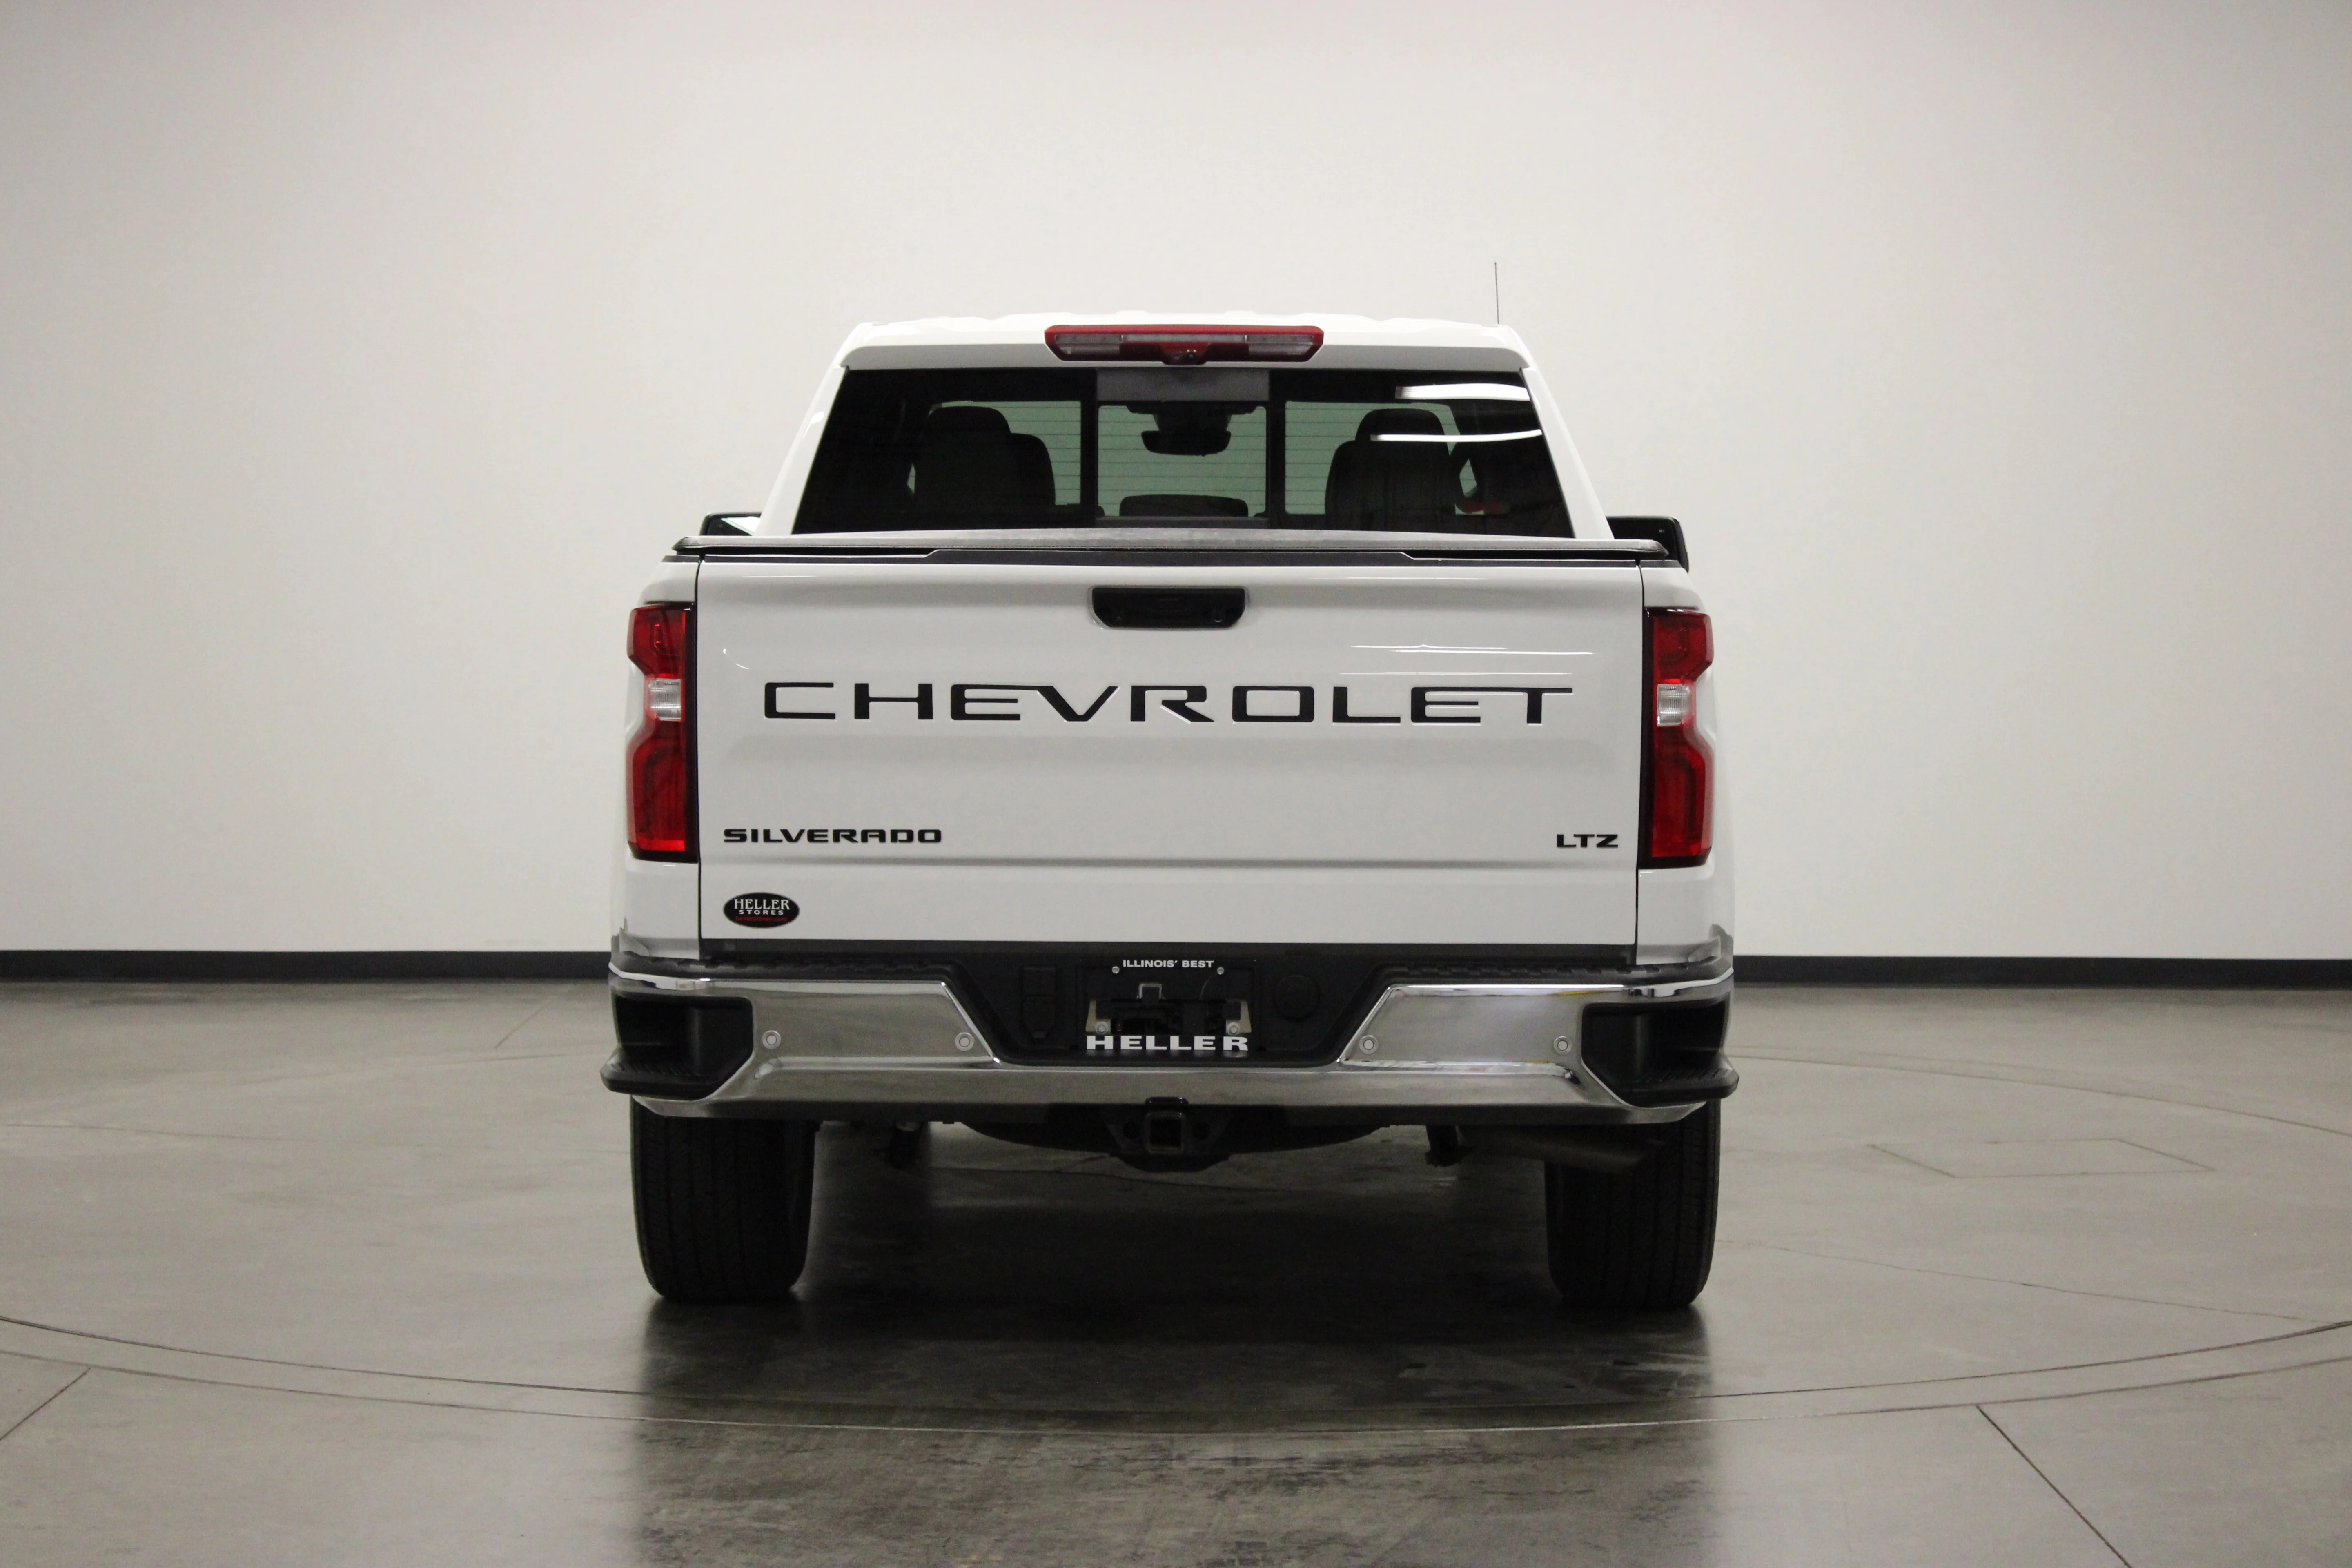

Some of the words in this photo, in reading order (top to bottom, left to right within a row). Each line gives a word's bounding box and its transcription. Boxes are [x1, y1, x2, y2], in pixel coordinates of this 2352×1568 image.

[764, 682, 1572, 724] CHEVROLET
[724, 829, 942, 844] SILVERADO
[1556, 834, 1618, 848] LTZ
[734, 899, 791, 910] HELLER
[1123, 960, 1178, 968] ILLINOIS'
[1087, 1036, 1248, 1051] HELLER
